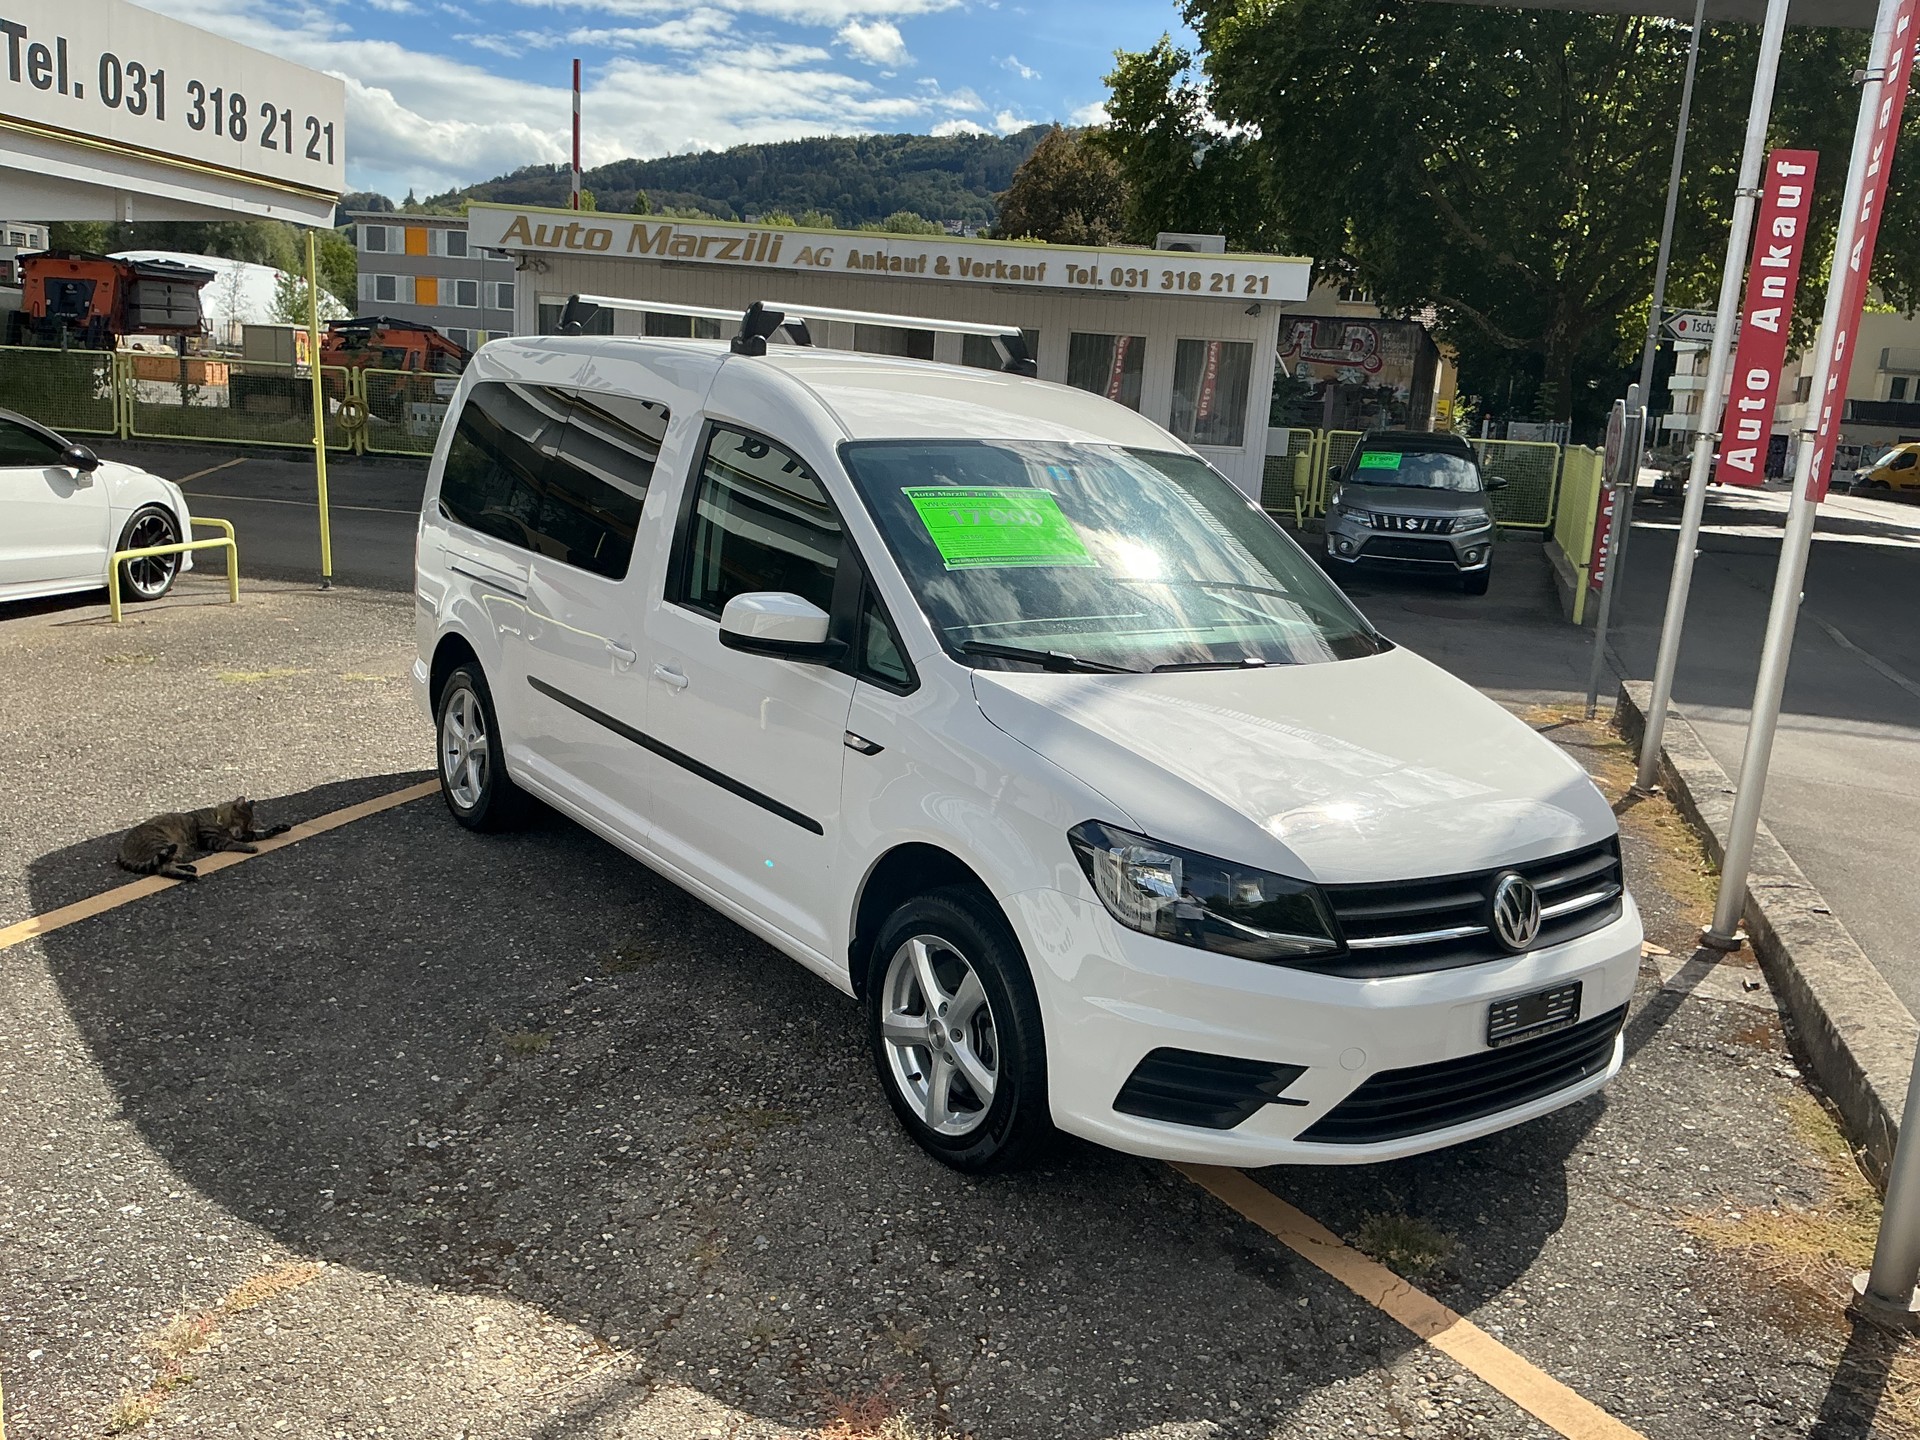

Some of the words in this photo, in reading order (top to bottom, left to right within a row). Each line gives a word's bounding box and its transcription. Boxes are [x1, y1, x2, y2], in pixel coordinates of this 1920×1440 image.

[0, 18, 84, 100] Tel.
[99, 52, 165, 121] 031
[186, 79, 247, 142] 318
[260, 102, 292, 154] 21
[305, 115, 334, 165] 21
[499, 215, 613, 251] Auto
[626, 223, 784, 263] Marzili
[793, 246, 834, 267] AG
[846, 250, 927, 273] Ankauf
[934, 255, 951, 275] &
[957, 256, 1047, 281] Verkauf
[1065, 264, 1103, 285] Tel.
[1110, 267, 1149, 288] 031
[1161, 270, 1202, 291] 318
[1209, 273, 1235, 293] 21
[1243, 275, 1269, 295] 21
[1726, 367, 1770, 473] Auto
[1750, 160, 1806, 334] Ankauf
[1811, 330, 1847, 484] Auto
